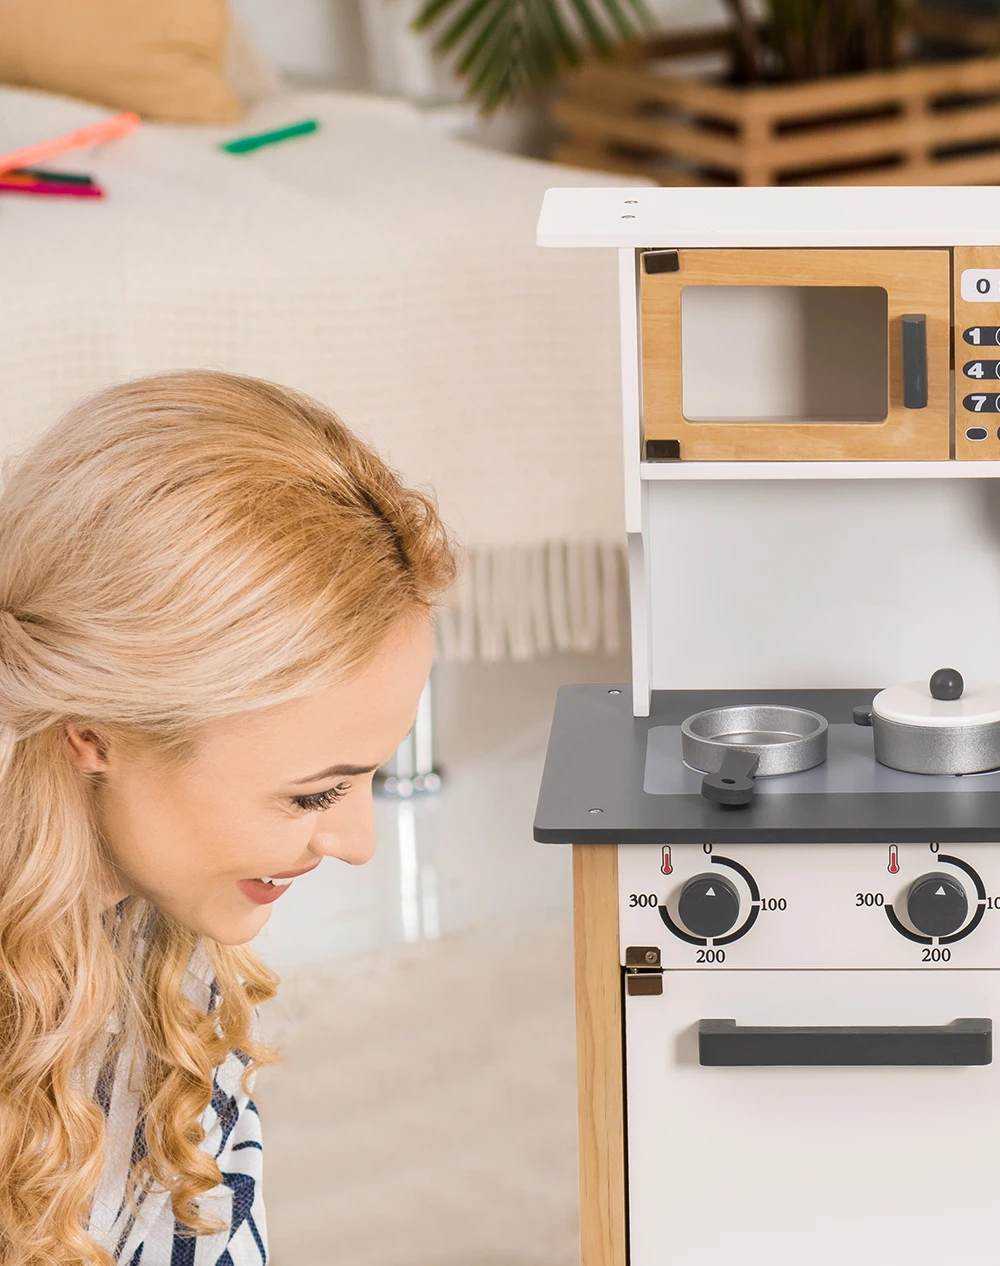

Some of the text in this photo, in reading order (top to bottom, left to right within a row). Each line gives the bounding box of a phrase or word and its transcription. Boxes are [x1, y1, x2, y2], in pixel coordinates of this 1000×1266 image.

[969, 328, 981, 344] 1
[967, 363, 984, 378] 4
[971, 396, 987, 411] 7
[629, 894, 659, 908] 300
[761, 897, 787, 911] 100
[855, 893, 884, 907] 300
[696, 949, 726, 963] 200
[922, 948, 951, 962] 200
